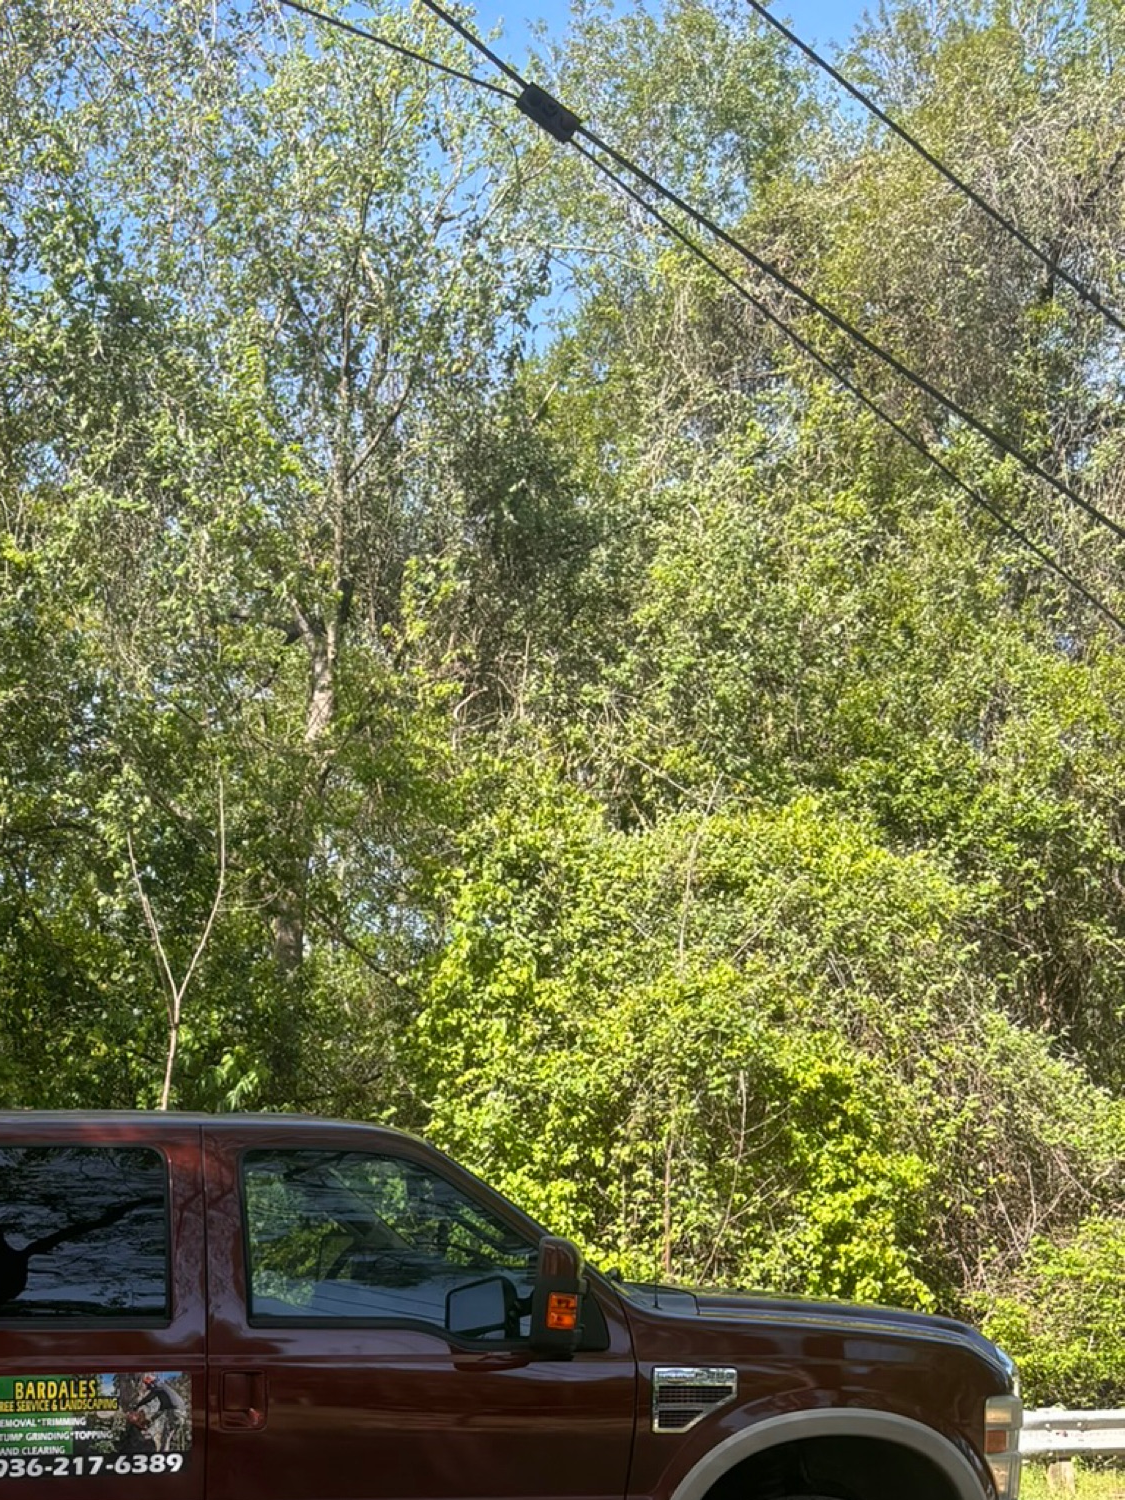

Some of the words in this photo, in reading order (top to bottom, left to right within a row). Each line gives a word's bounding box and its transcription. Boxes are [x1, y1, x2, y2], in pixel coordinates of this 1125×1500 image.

[14, 1380, 97, 1400] BARDALES
[16, 1399, 49, 1411] SERVICE
[60, 1398, 118, 1410] LANDSCAPING
[26, 1431, 69, 1441] GRINDING
[22, 1446, 65, 1454] CLEARING
